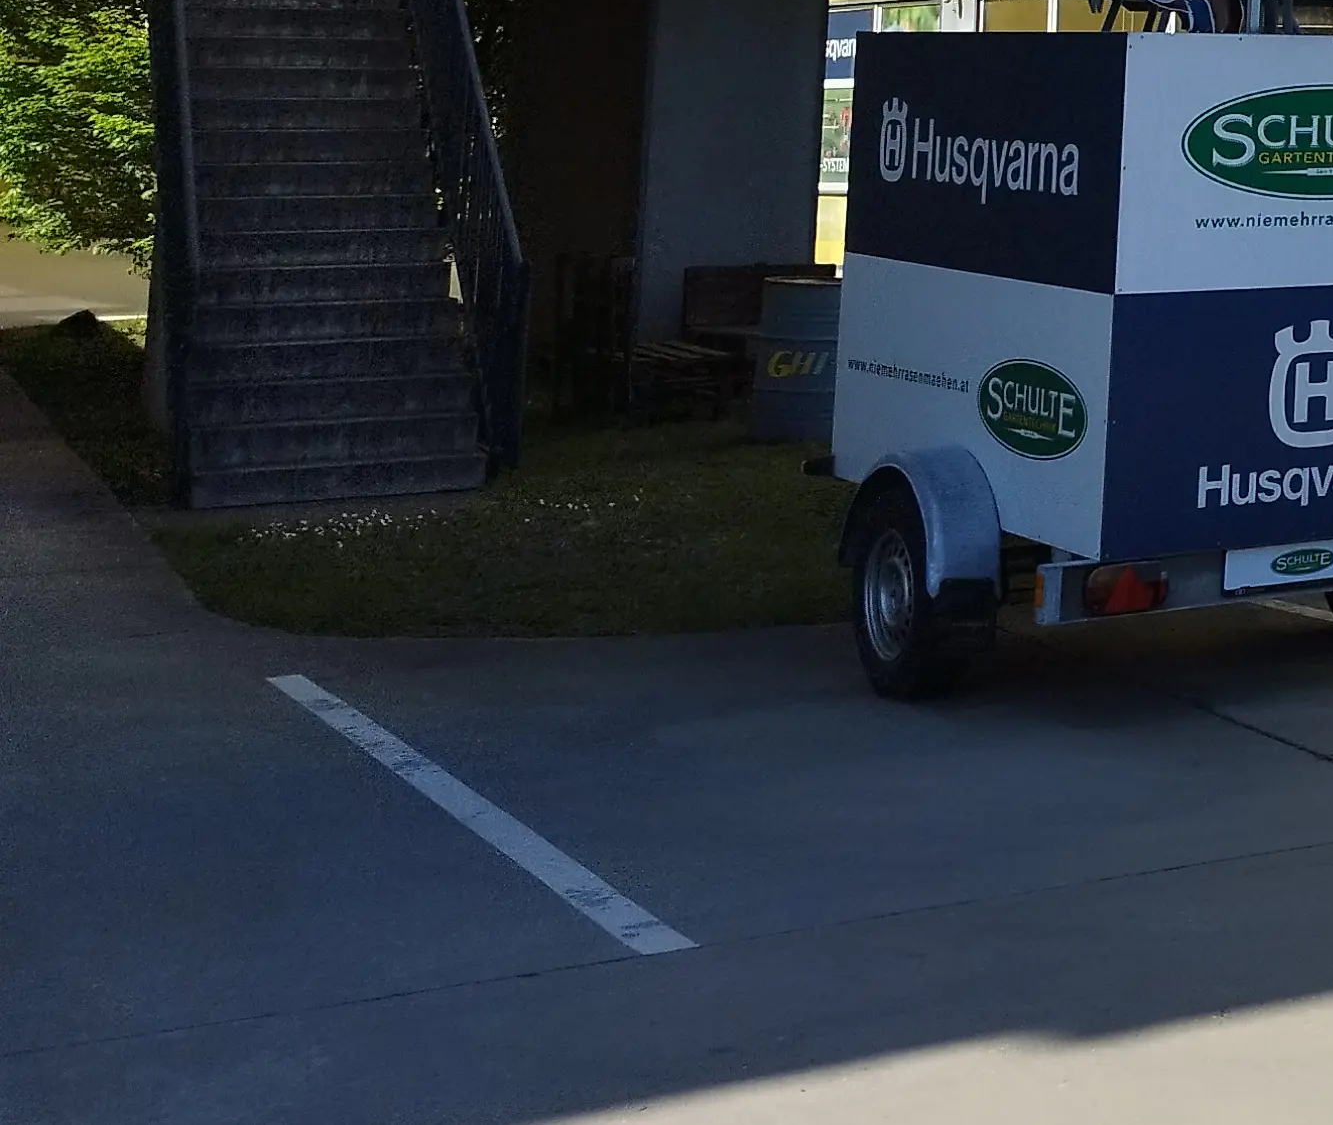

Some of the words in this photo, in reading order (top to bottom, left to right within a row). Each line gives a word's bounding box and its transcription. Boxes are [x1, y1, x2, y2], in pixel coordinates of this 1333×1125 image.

[911, 117, 1079, 205] Husqvarna
[986, 376, 1077, 439] SCHULTE
[1275, 552, 1331, 571] SCHULTE
